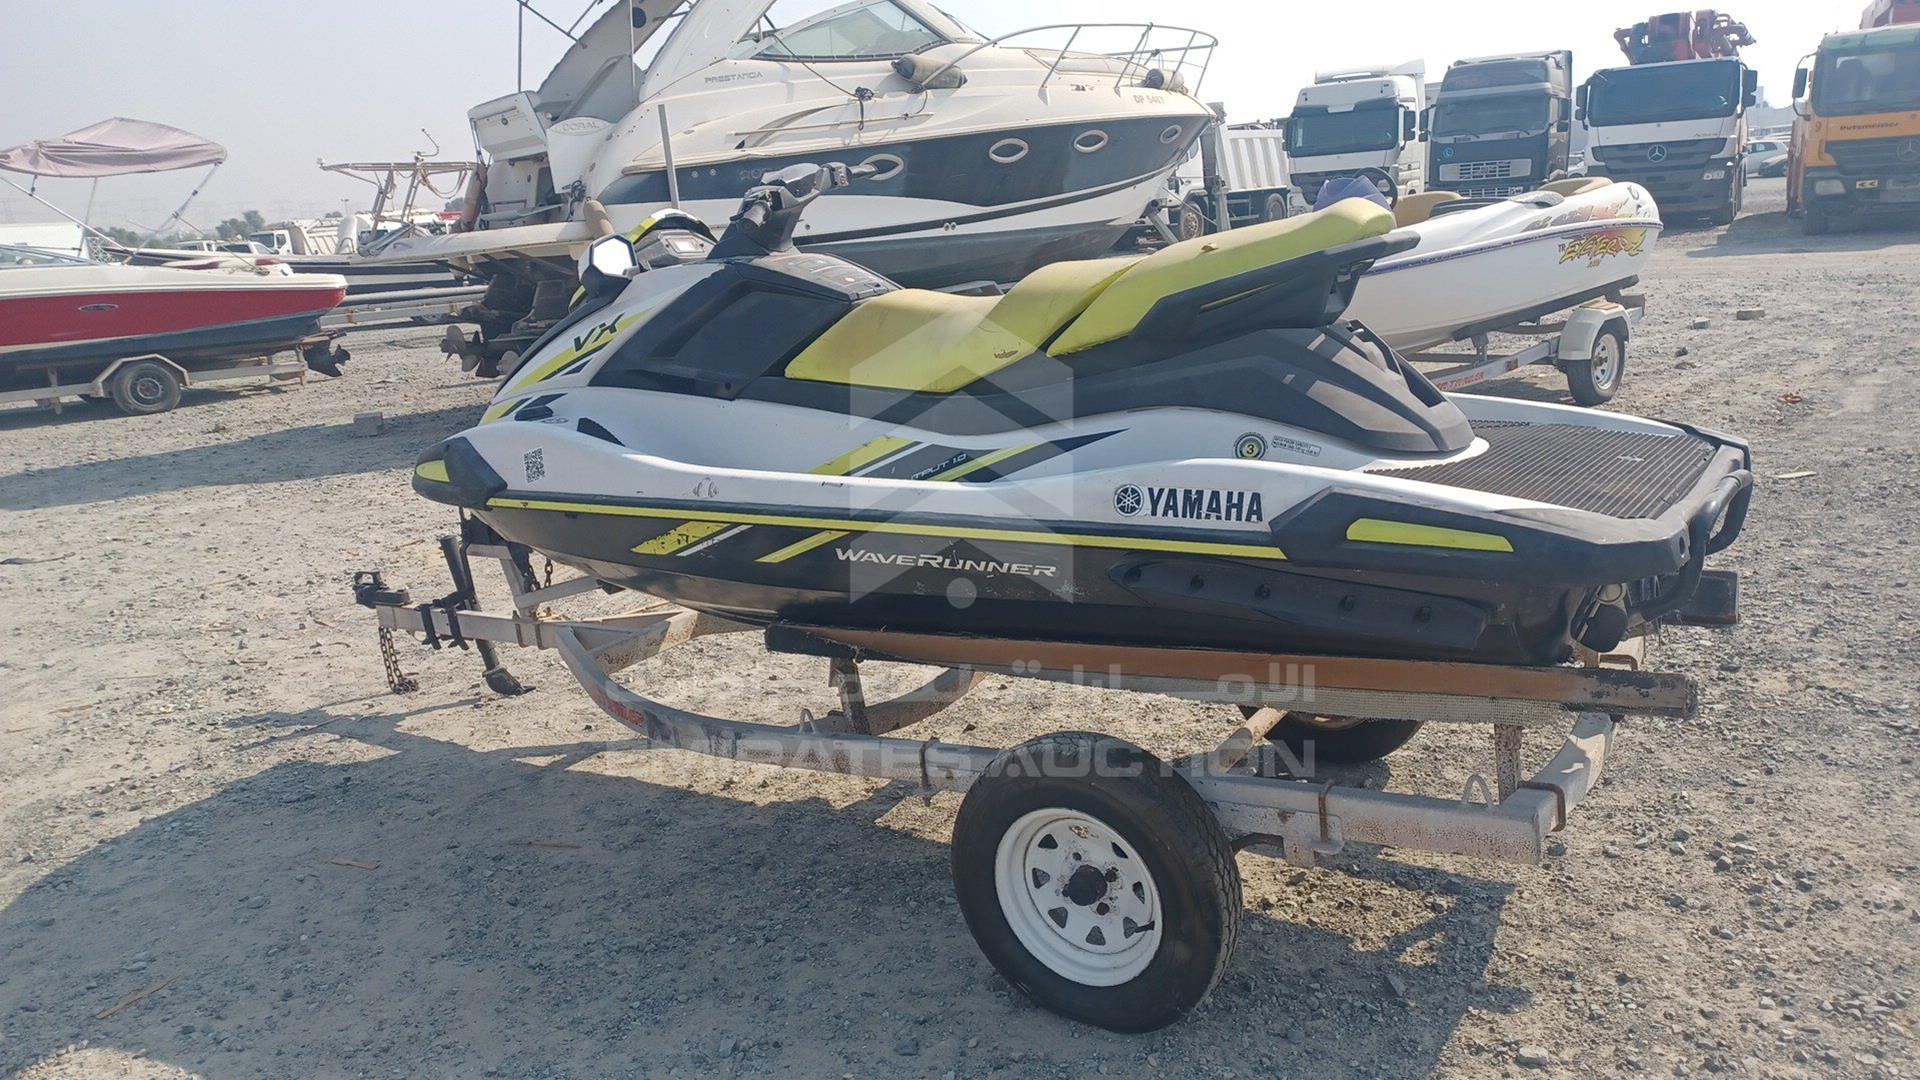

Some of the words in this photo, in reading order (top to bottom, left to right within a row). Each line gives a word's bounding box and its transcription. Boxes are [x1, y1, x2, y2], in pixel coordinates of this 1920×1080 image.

[573, 311, 625, 352] VX
[1246, 443, 1255, 455] 3
[1148, 487, 1264, 523] YAMAHA
